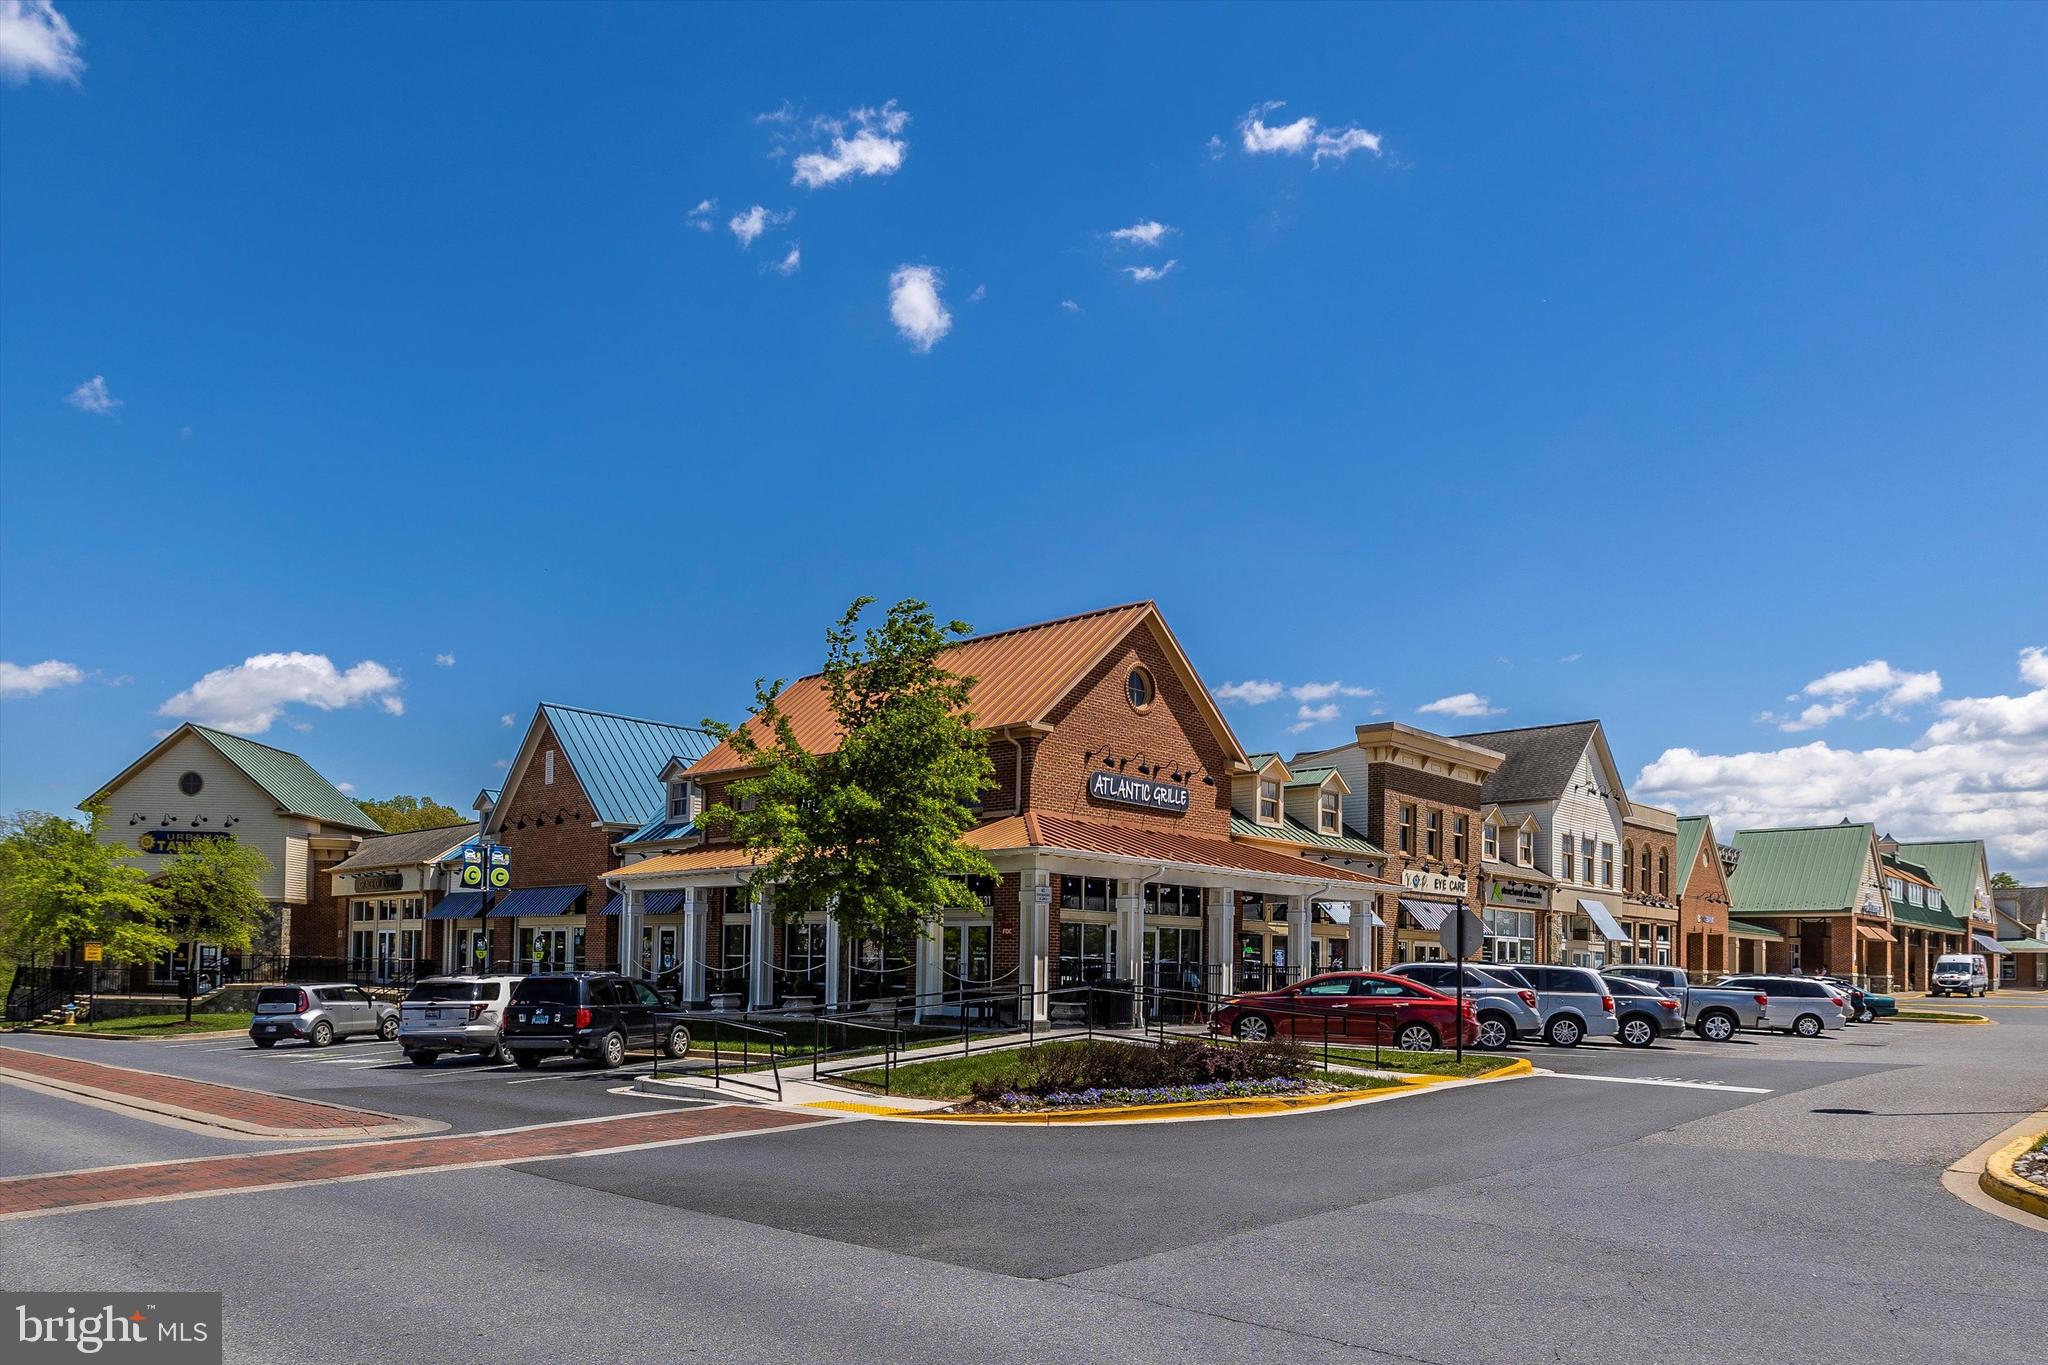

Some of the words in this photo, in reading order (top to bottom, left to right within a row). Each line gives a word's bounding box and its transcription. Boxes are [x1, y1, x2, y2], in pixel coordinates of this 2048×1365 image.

[1093, 774, 1151, 802] ATLANTIC
[1153, 786, 1187, 806] GRILLE
[468, 870, 478, 881] C
[495, 872, 505, 882] C
[1434, 878, 1447, 890] EYE
[1449, 880, 1466, 892] CARE
